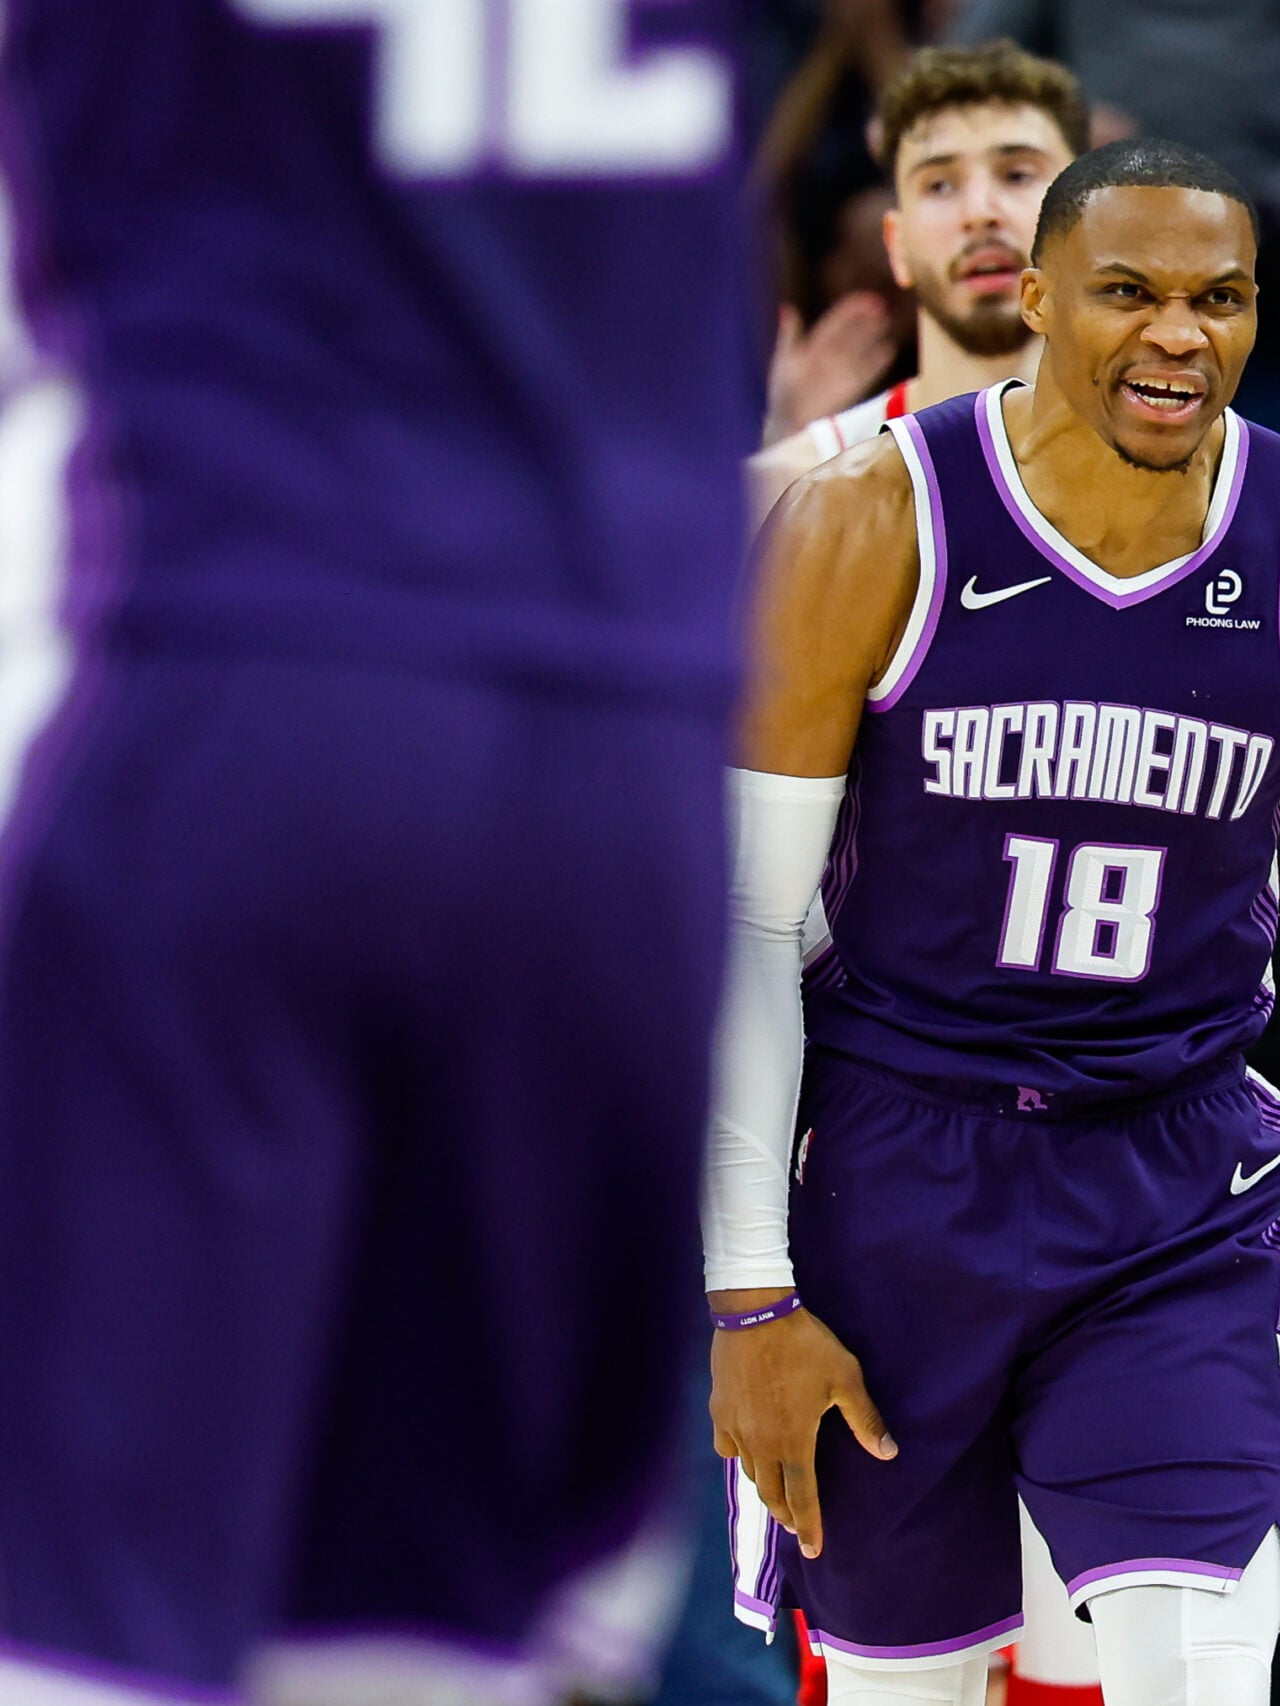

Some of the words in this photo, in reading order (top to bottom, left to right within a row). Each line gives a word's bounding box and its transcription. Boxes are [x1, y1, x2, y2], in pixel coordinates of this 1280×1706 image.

[1186, 617, 1233, 628] PHOONG
[1234, 619, 1260, 630] LAW
[921, 700, 1275, 822] SACRAMENTO
[995, 832, 1168, 983] 18
